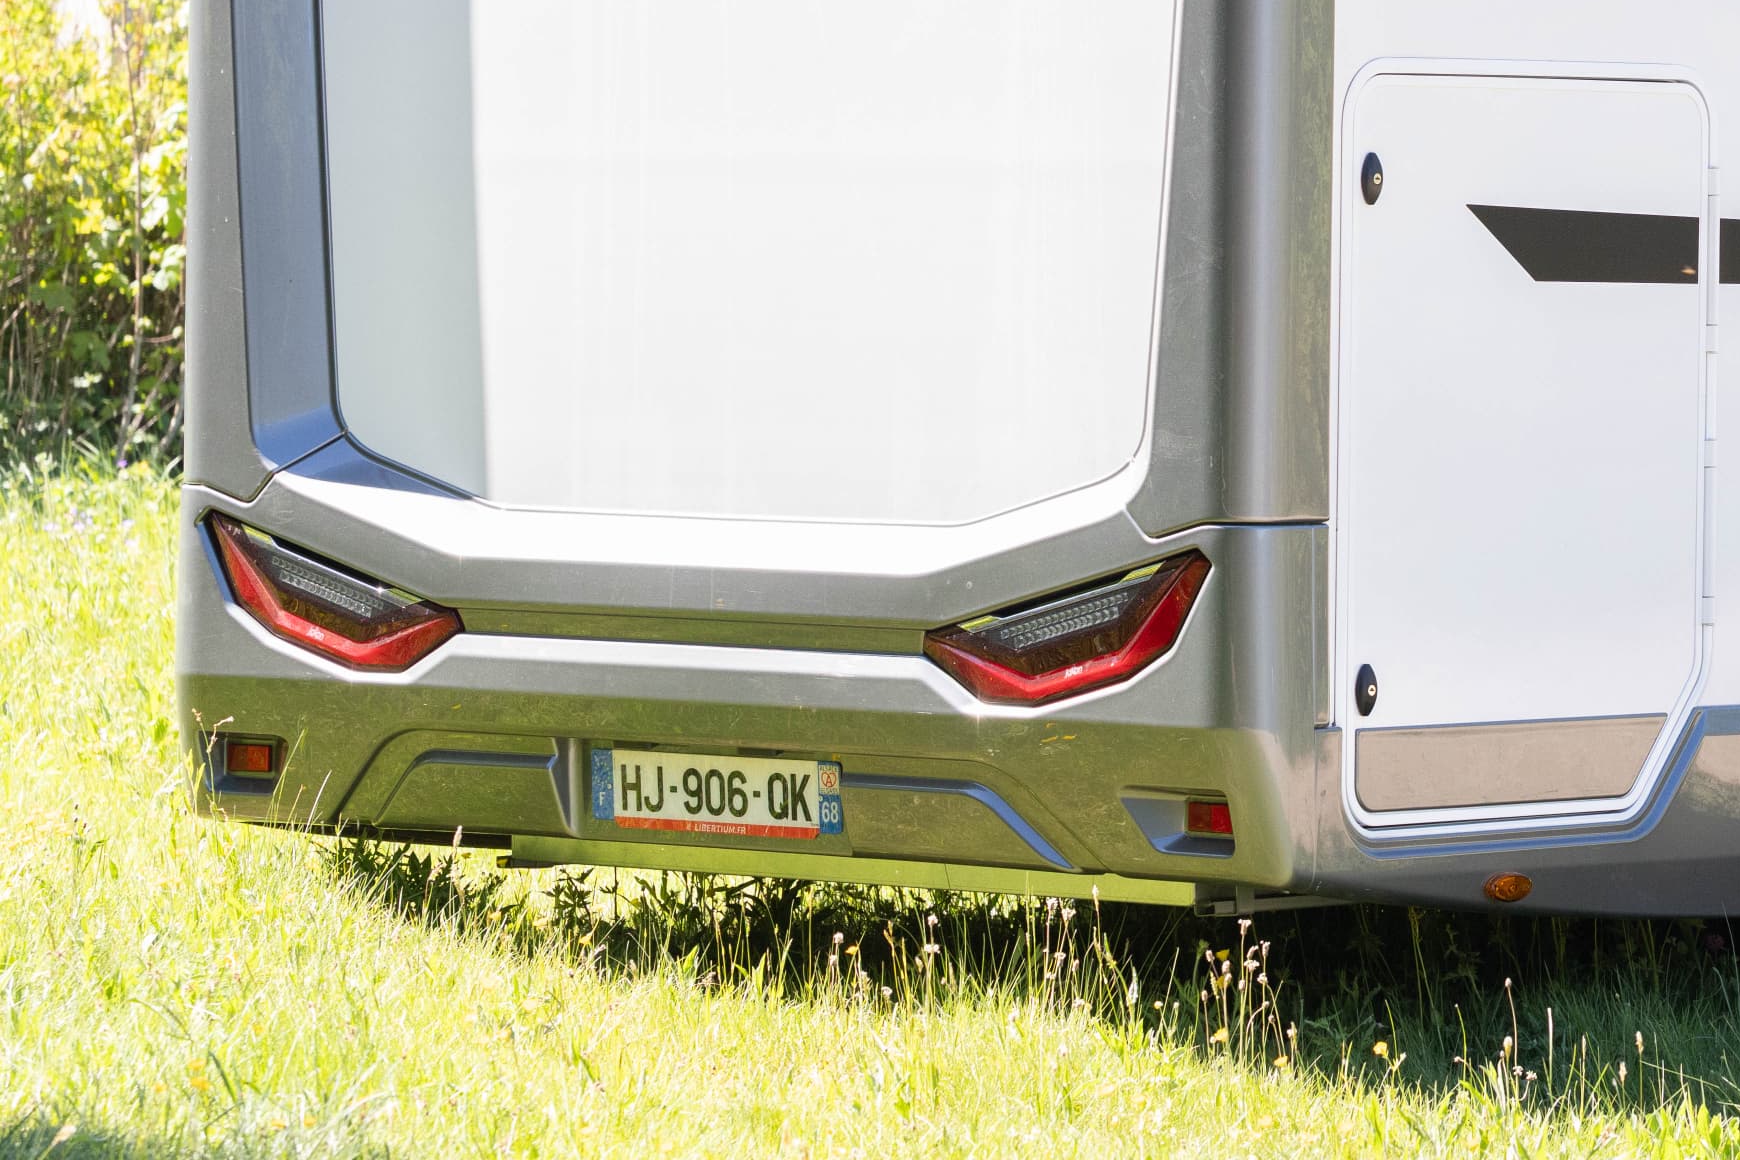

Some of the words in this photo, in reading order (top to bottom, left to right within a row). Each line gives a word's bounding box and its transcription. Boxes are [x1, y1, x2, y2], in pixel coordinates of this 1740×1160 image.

[599, 791, 606, 807] F
[620, 763, 812, 822] HJ-906-QK
[822, 801, 839, 824] 68
[694, 823, 747, 836] LIBERTIUM.FR
